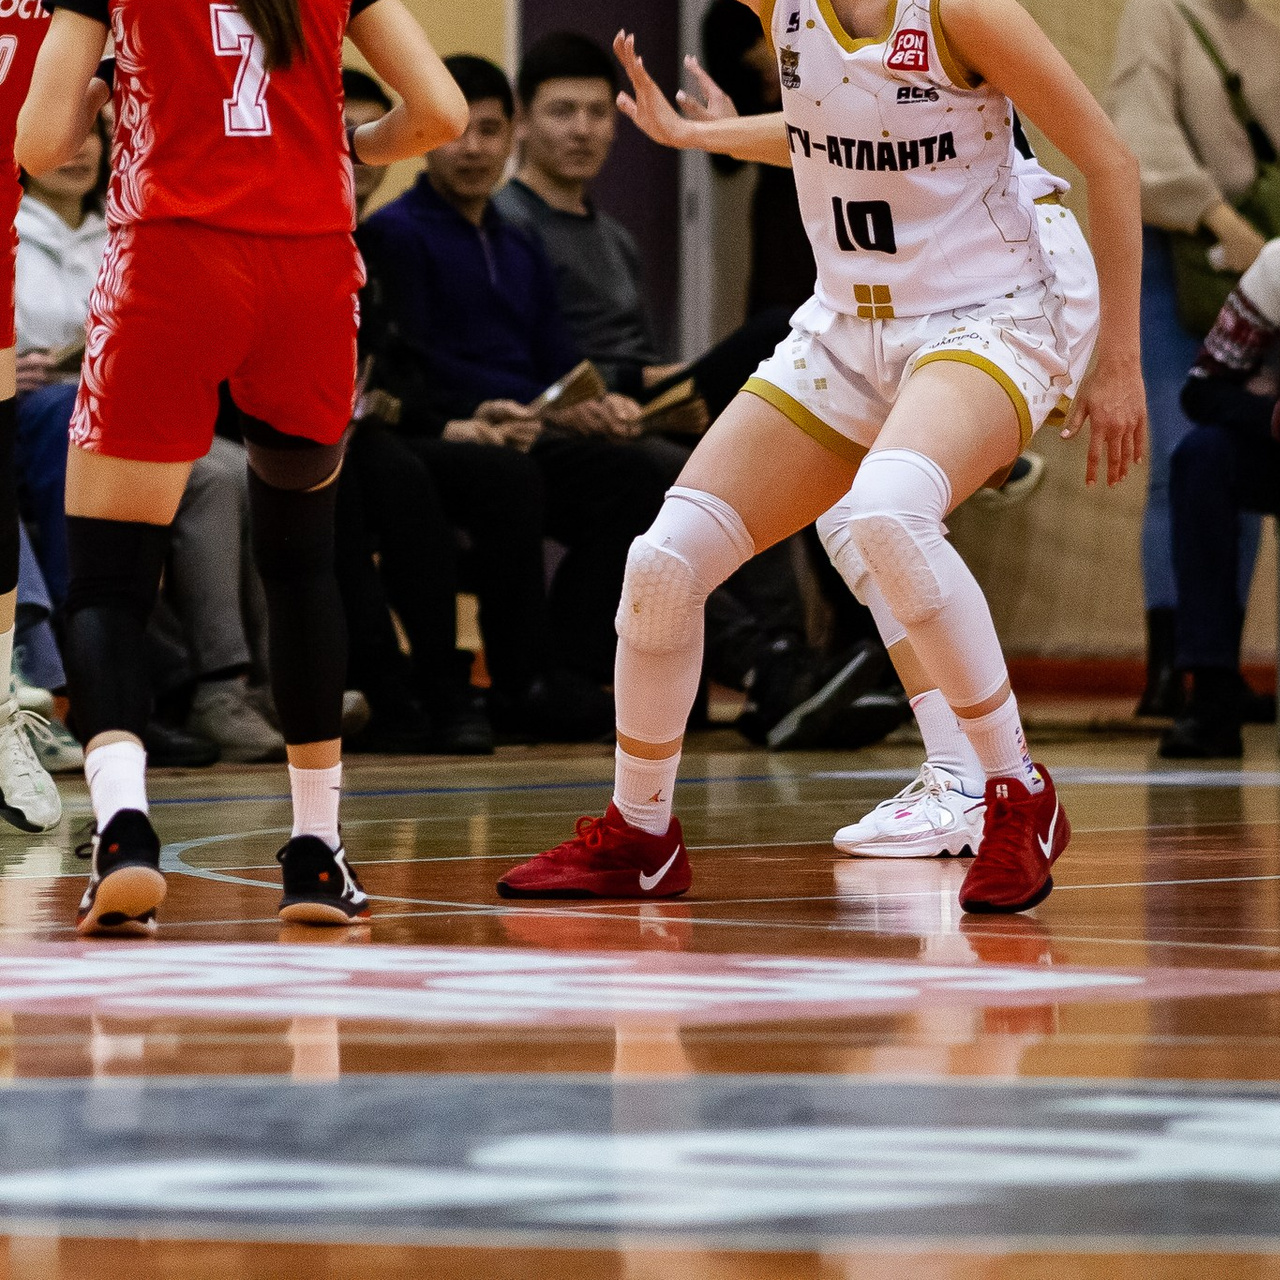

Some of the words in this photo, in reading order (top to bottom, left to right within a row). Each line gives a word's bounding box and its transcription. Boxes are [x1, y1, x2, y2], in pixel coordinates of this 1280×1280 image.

[889, 49, 925, 66] BET
[896, 33, 925, 51] FON
[208, 2, 272, 137] 7
[785, 121, 957, 172] ГУ-АТЛАНТА
[831, 196, 897, 255] 10
